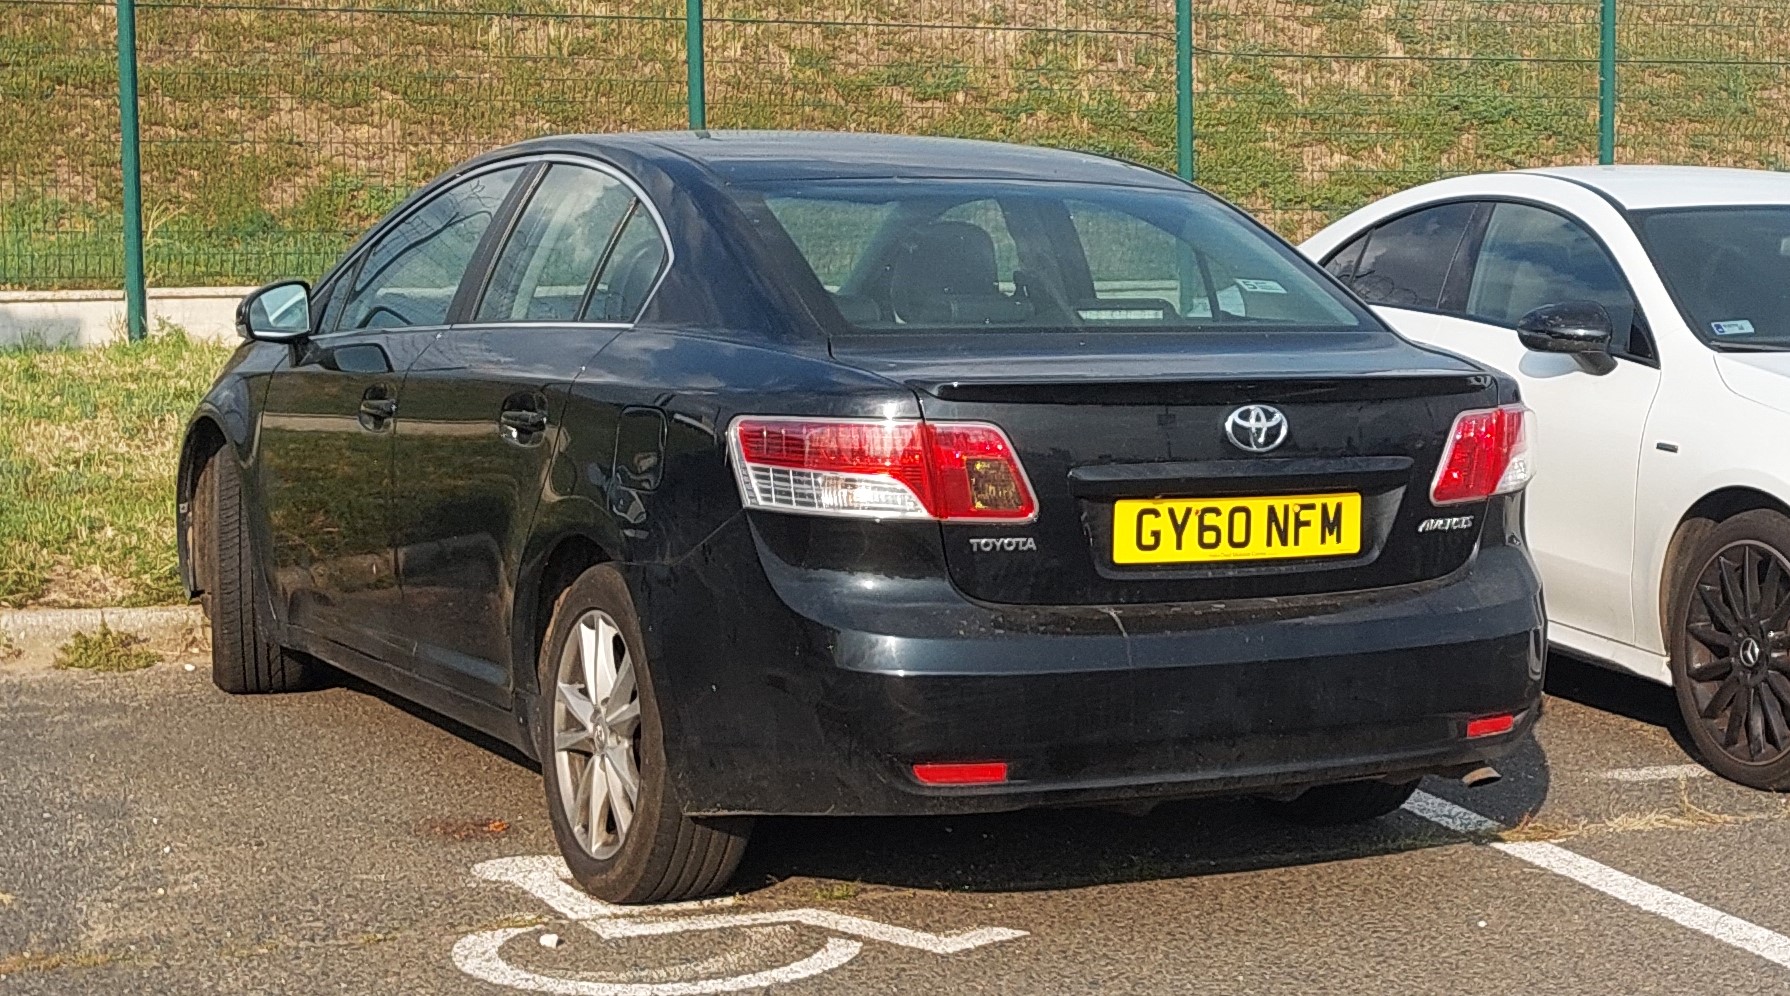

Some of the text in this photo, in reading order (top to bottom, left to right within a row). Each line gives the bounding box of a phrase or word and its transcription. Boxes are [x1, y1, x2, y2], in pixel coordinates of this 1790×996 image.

[1136, 502, 1343, 552] GY60 NFM
[969, 537, 1037, 551] TOYOTA
